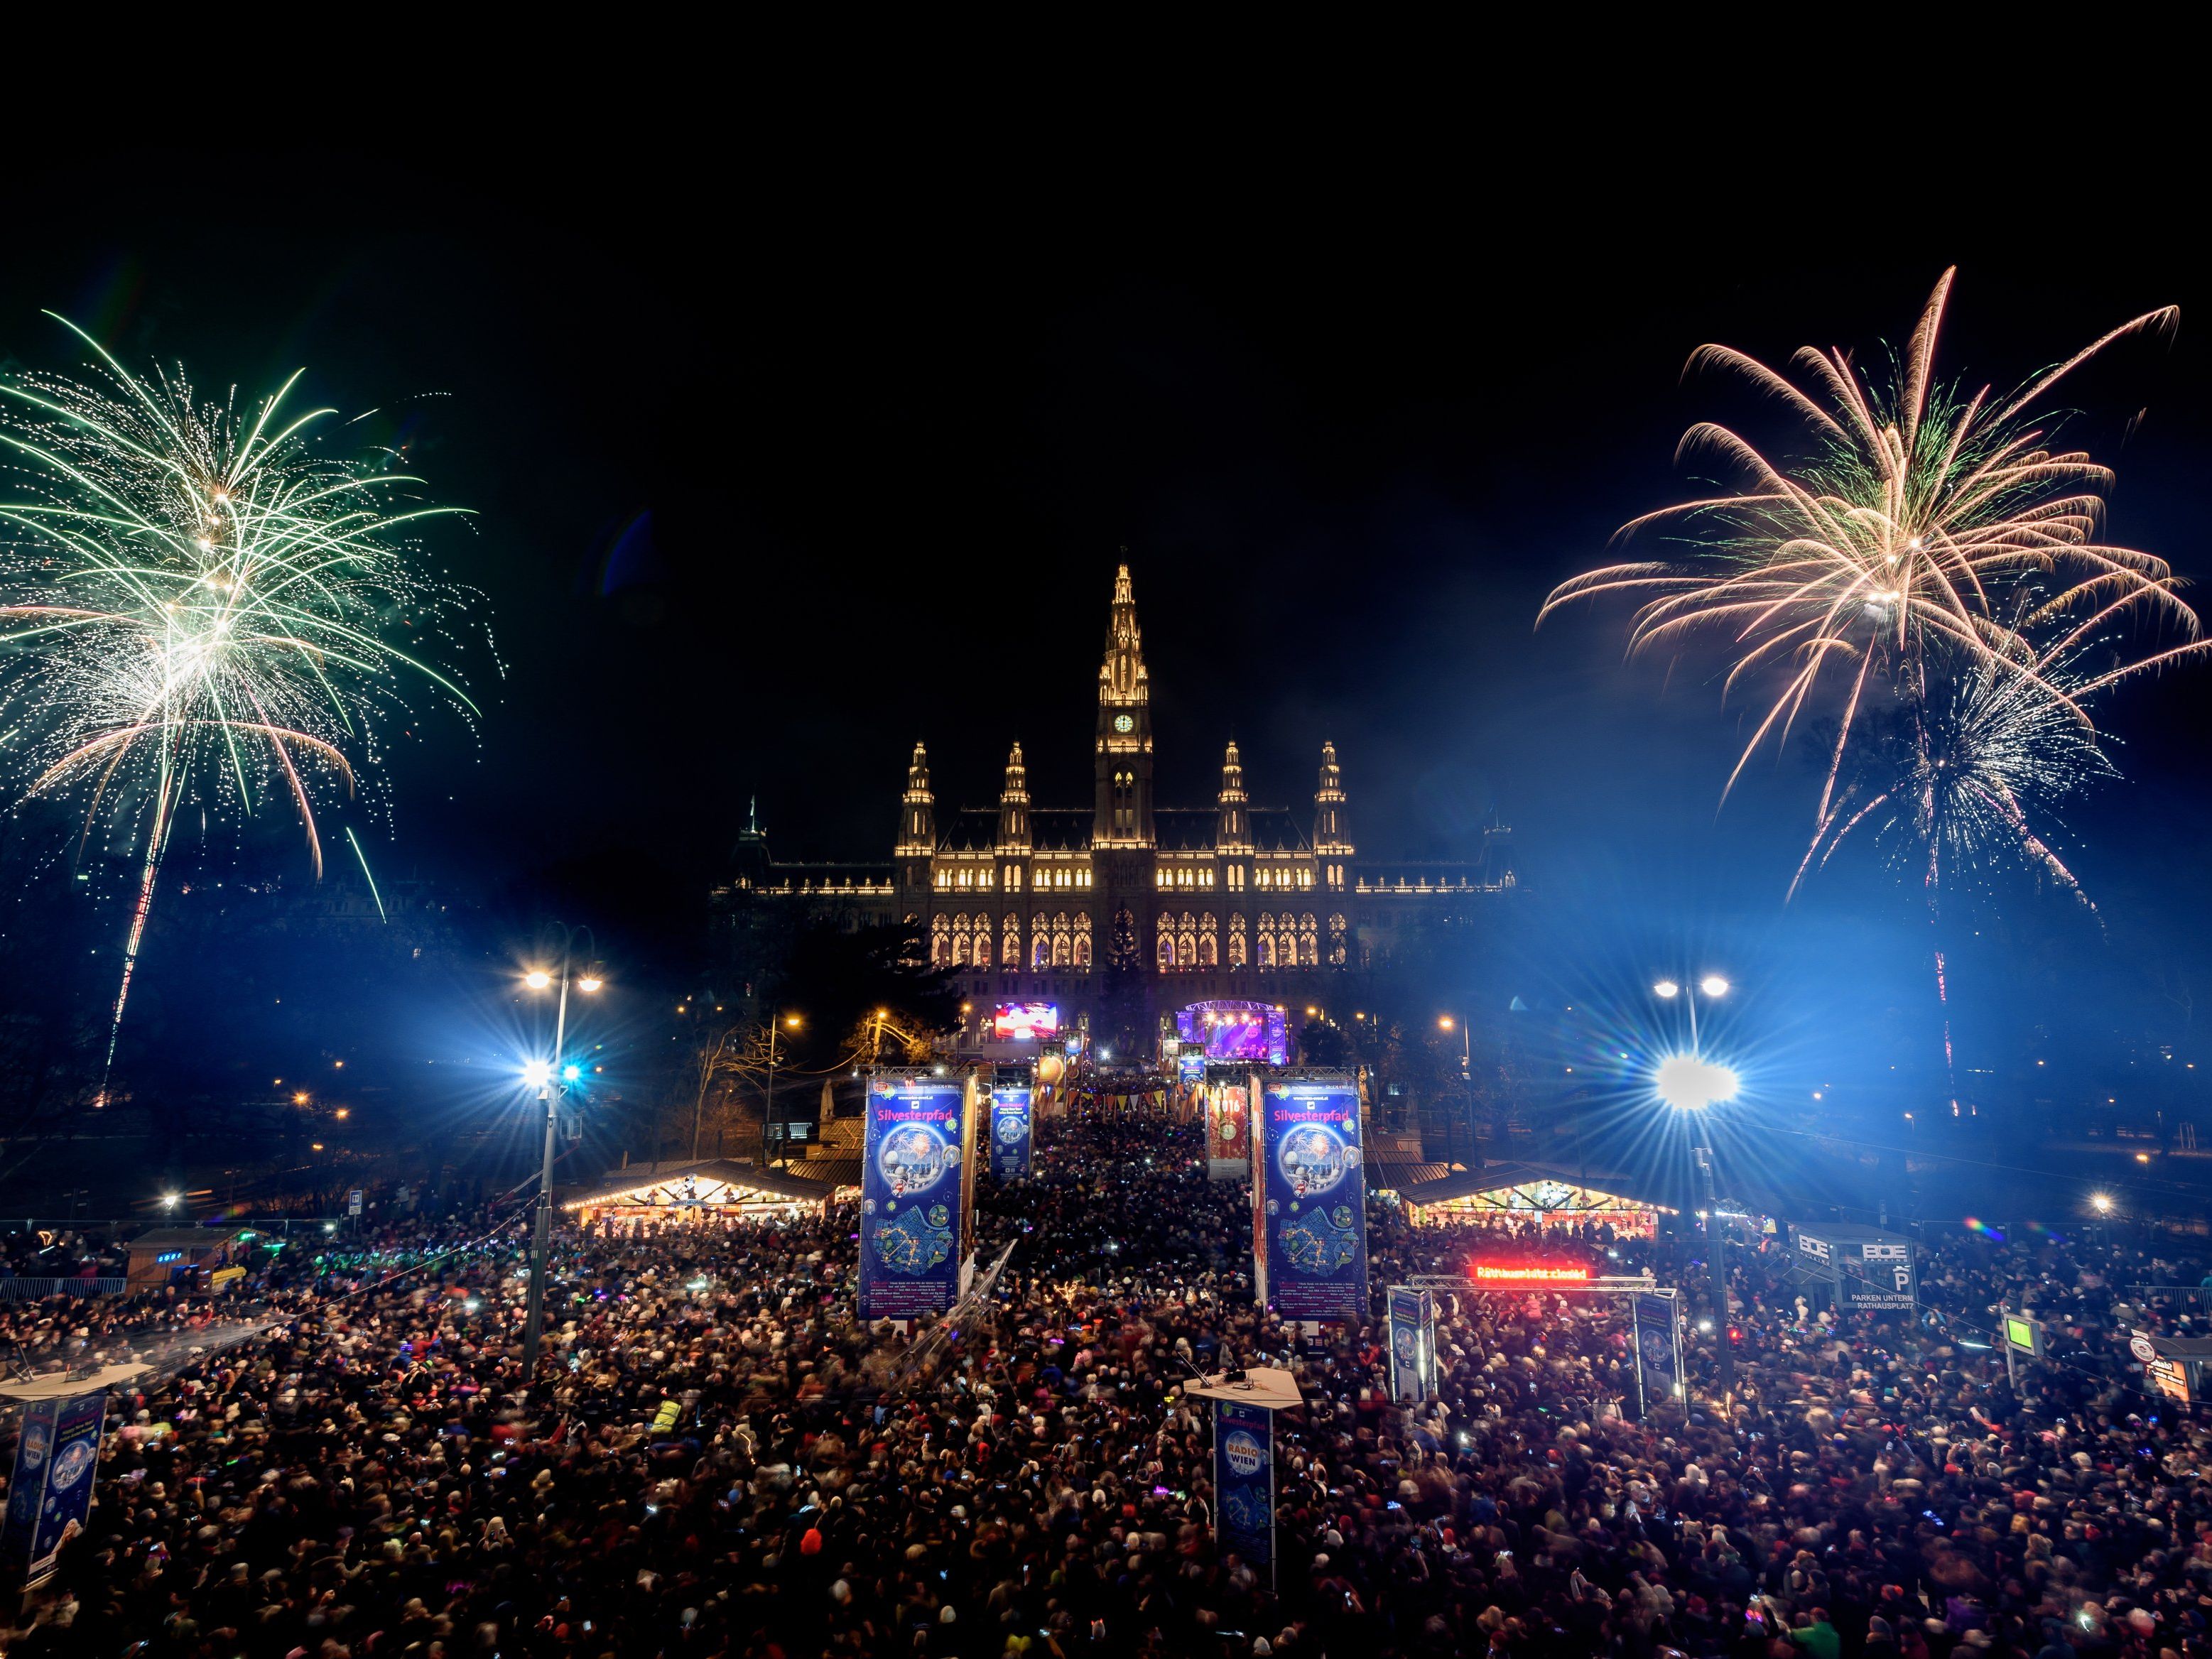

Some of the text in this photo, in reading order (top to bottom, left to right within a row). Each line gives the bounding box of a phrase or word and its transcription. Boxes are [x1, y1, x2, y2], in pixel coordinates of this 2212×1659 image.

[1214, 1099, 1240, 1112] 2016
[877, 1109, 953, 1123] Silvesterpfad
[1274, 1109, 1349, 1124] Silvesterpfad
[1799, 1234, 1830, 1260] BOE
[1862, 1244, 1907, 1259] BOE
[1219, 1415, 1266, 1430] Silvesterpfad
[26, 1449, 40, 1461] WIEN
[1228, 1443, 1259, 1457] RADIO
[1231, 1454, 1256, 1467] WIEN
